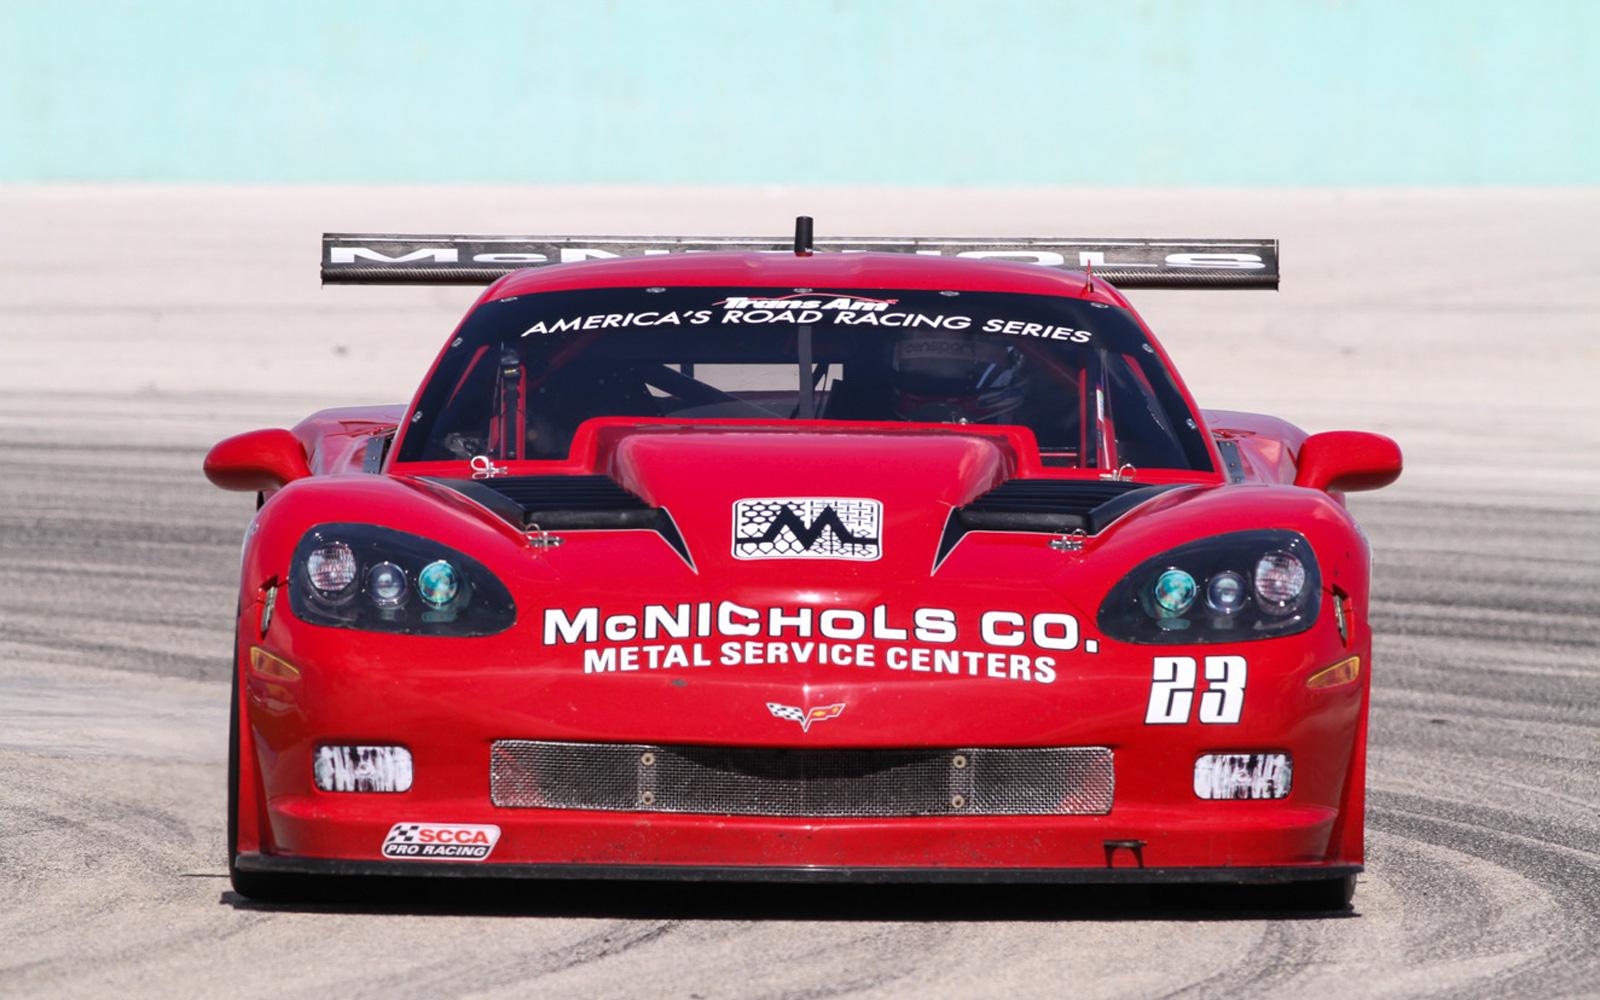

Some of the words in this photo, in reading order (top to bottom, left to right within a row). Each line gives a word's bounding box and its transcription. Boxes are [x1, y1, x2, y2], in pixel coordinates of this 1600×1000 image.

[723, 297, 822, 310] Trans
[821, 298, 890, 311] Am
[521, 310, 713, 337] AMERICA'S
[721, 309, 824, 324] ROAD
[833, 310, 972, 330] RACING
[982, 318, 1092, 343] SERIES
[543, 600, 958, 645] McNICHOLS
[980, 611, 1099, 654] CO.
[583, 643, 712, 674] METAL
[719, 640, 876, 667] SERVICE
[886, 646, 1057, 684] CENTERS
[1144, 655, 1248, 725] 23
[386, 844, 420, 854] PRO
[422, 845, 487, 857] RACING
[418, 829, 490, 844] SCCA
